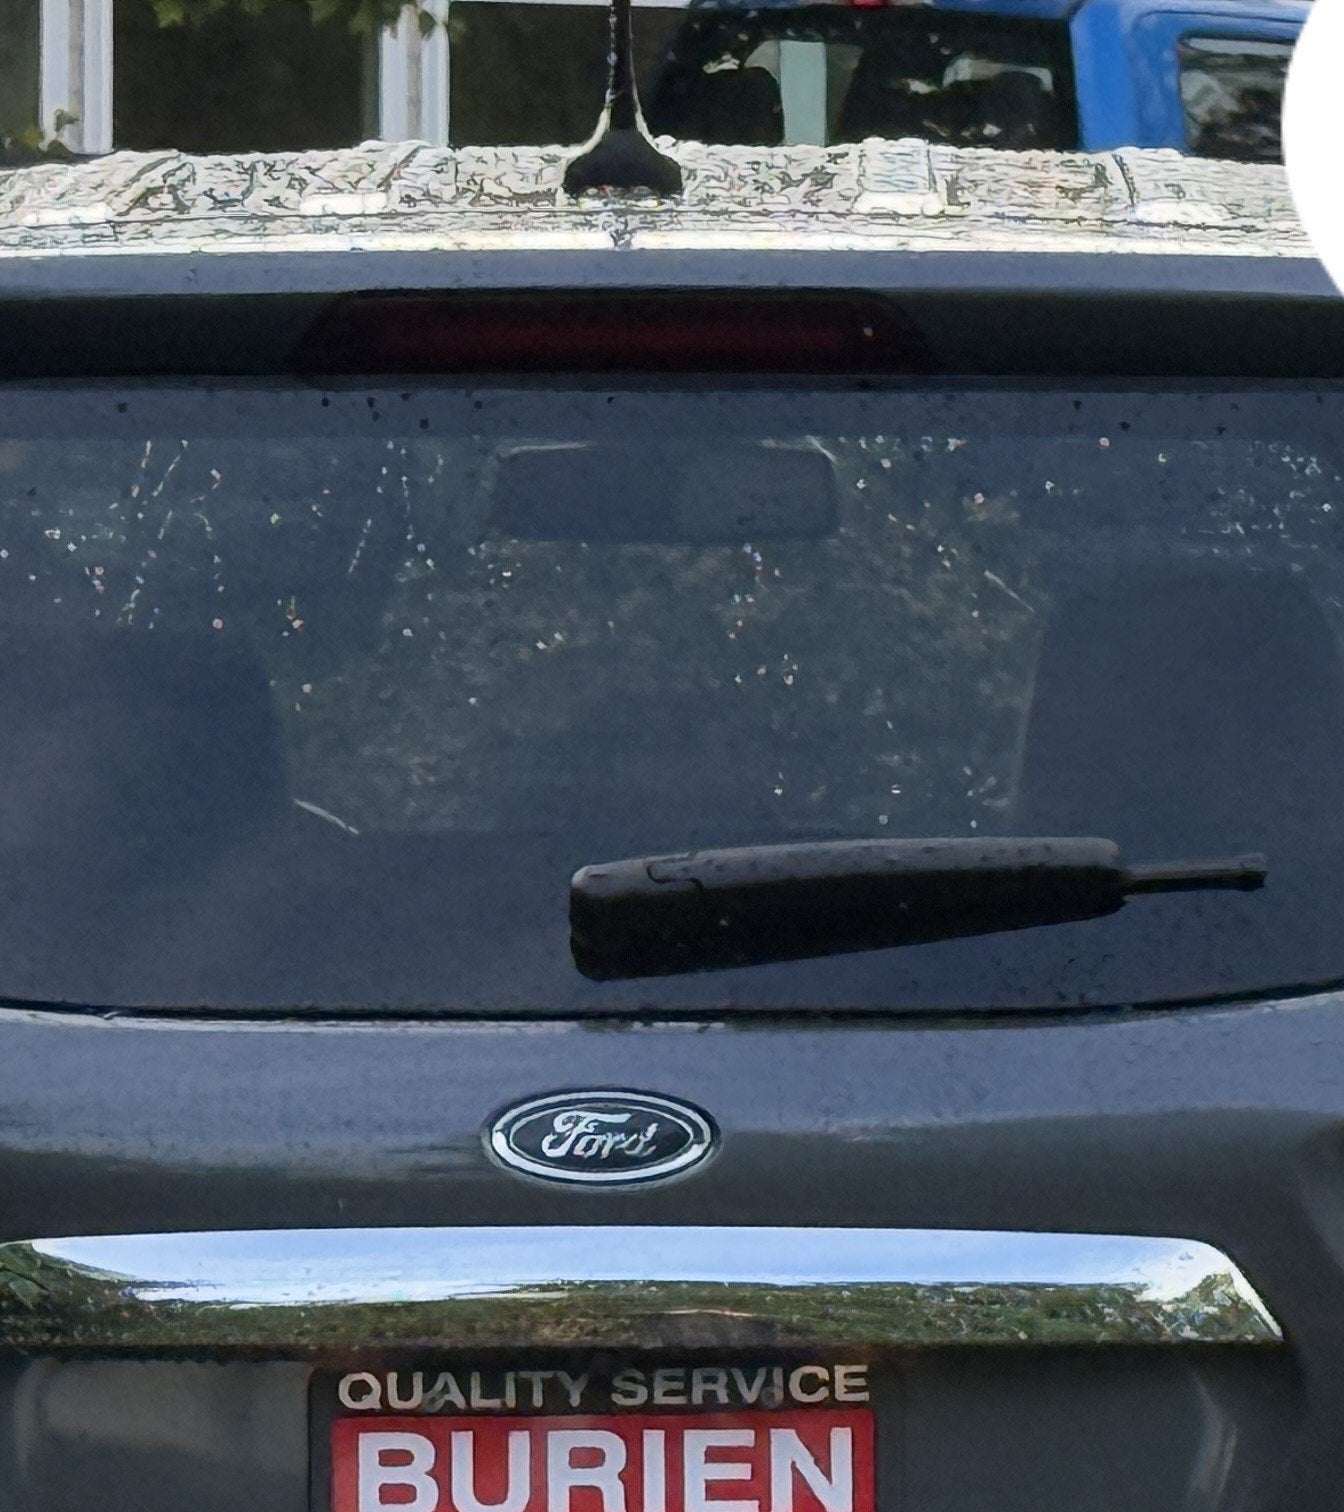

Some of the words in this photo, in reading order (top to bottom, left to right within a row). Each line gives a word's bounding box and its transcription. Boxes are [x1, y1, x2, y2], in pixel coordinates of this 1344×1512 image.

[541, 1109, 658, 1159] Ford
[337, 1371, 588, 1411] QUALITY
[610, 1364, 870, 1407] SERVICE
